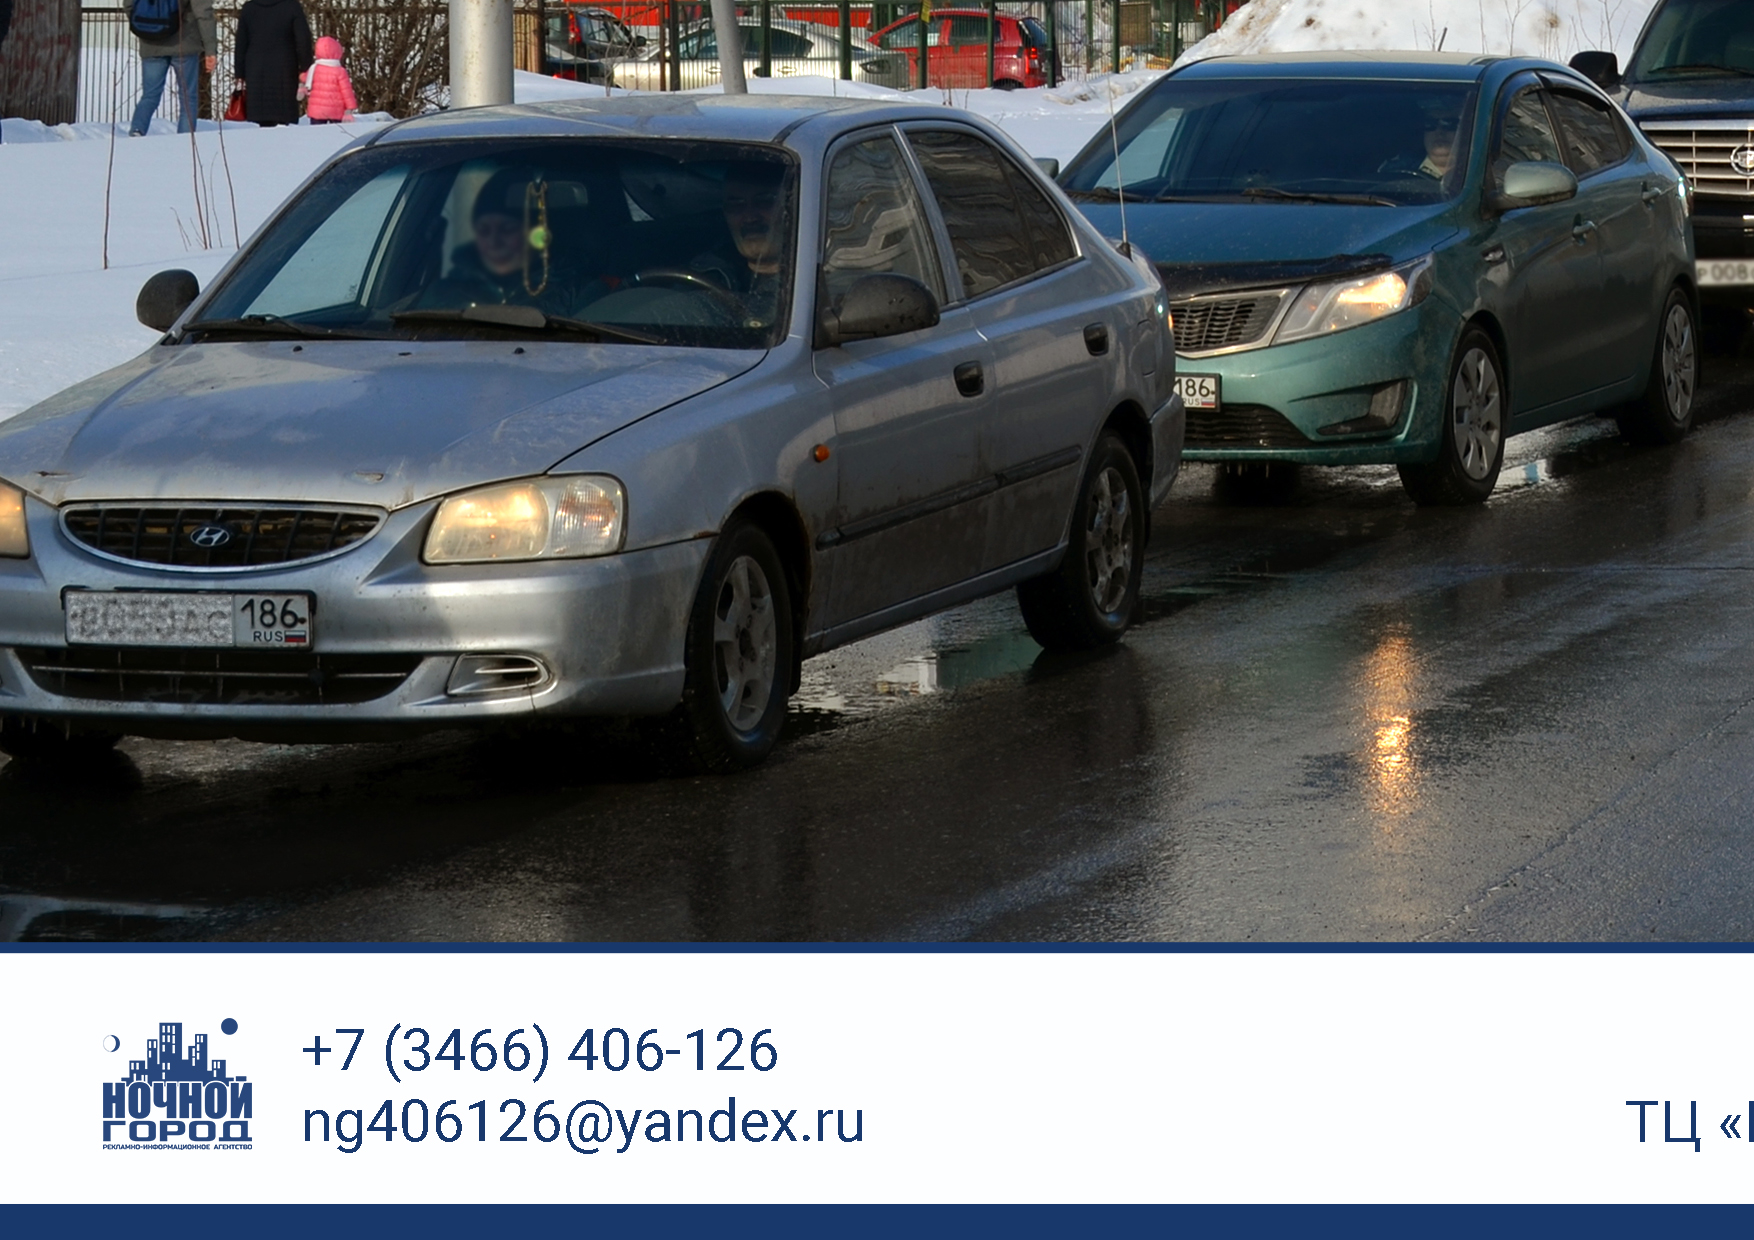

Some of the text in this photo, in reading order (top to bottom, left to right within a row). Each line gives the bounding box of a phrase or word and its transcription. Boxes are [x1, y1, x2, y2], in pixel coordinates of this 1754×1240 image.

[1174, 377, 1210, 398] 186
[241, 597, 299, 629] 186
[253, 630, 284, 643] RUS
